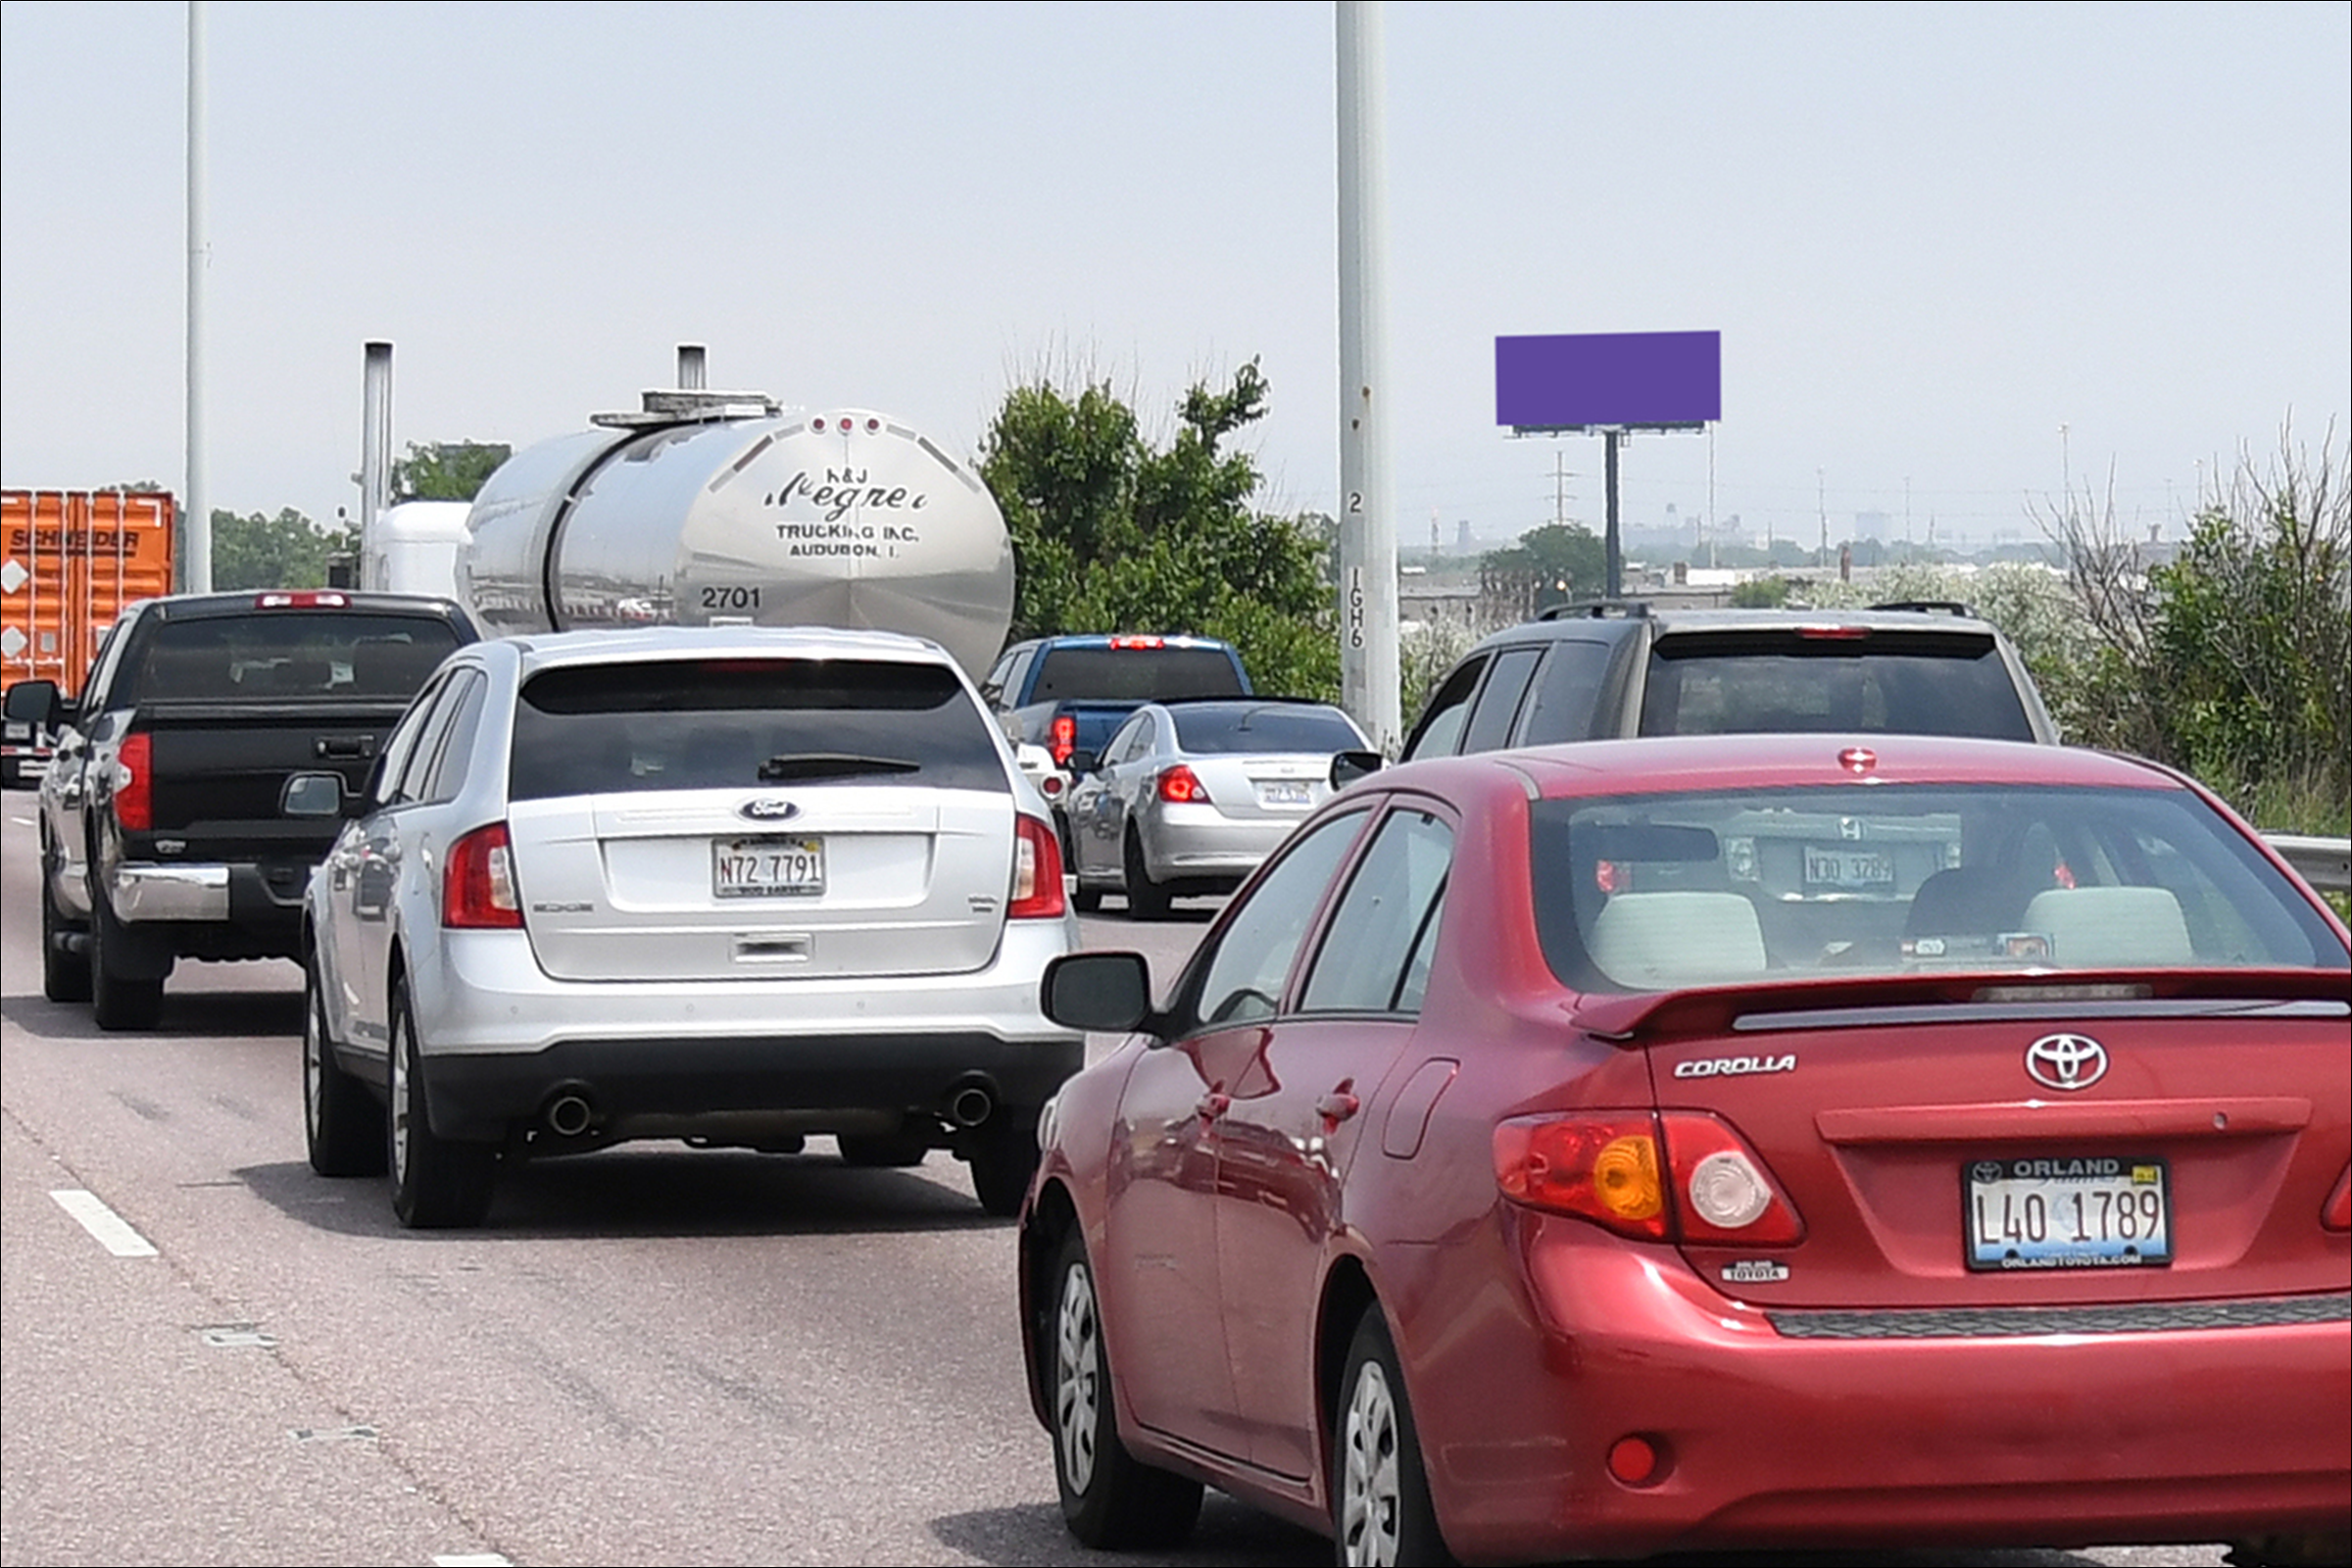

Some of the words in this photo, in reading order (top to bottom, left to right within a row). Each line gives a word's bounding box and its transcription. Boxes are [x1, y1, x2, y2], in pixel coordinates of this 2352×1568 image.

[11, 528, 140, 548] SCHNEDER
[702, 586, 760, 609] 2701
[720, 856, 759, 884] N72
[768, 855, 821, 883] 7791
[1674, 1054, 1797, 1078] COROLLA
[2014, 1159, 2120, 1177] ORLAND
[1977, 1194, 2047, 1245] L40
[2071, 1190, 2161, 1243] 1789
[1730, 1268, 1780, 1280] TOYOTA
